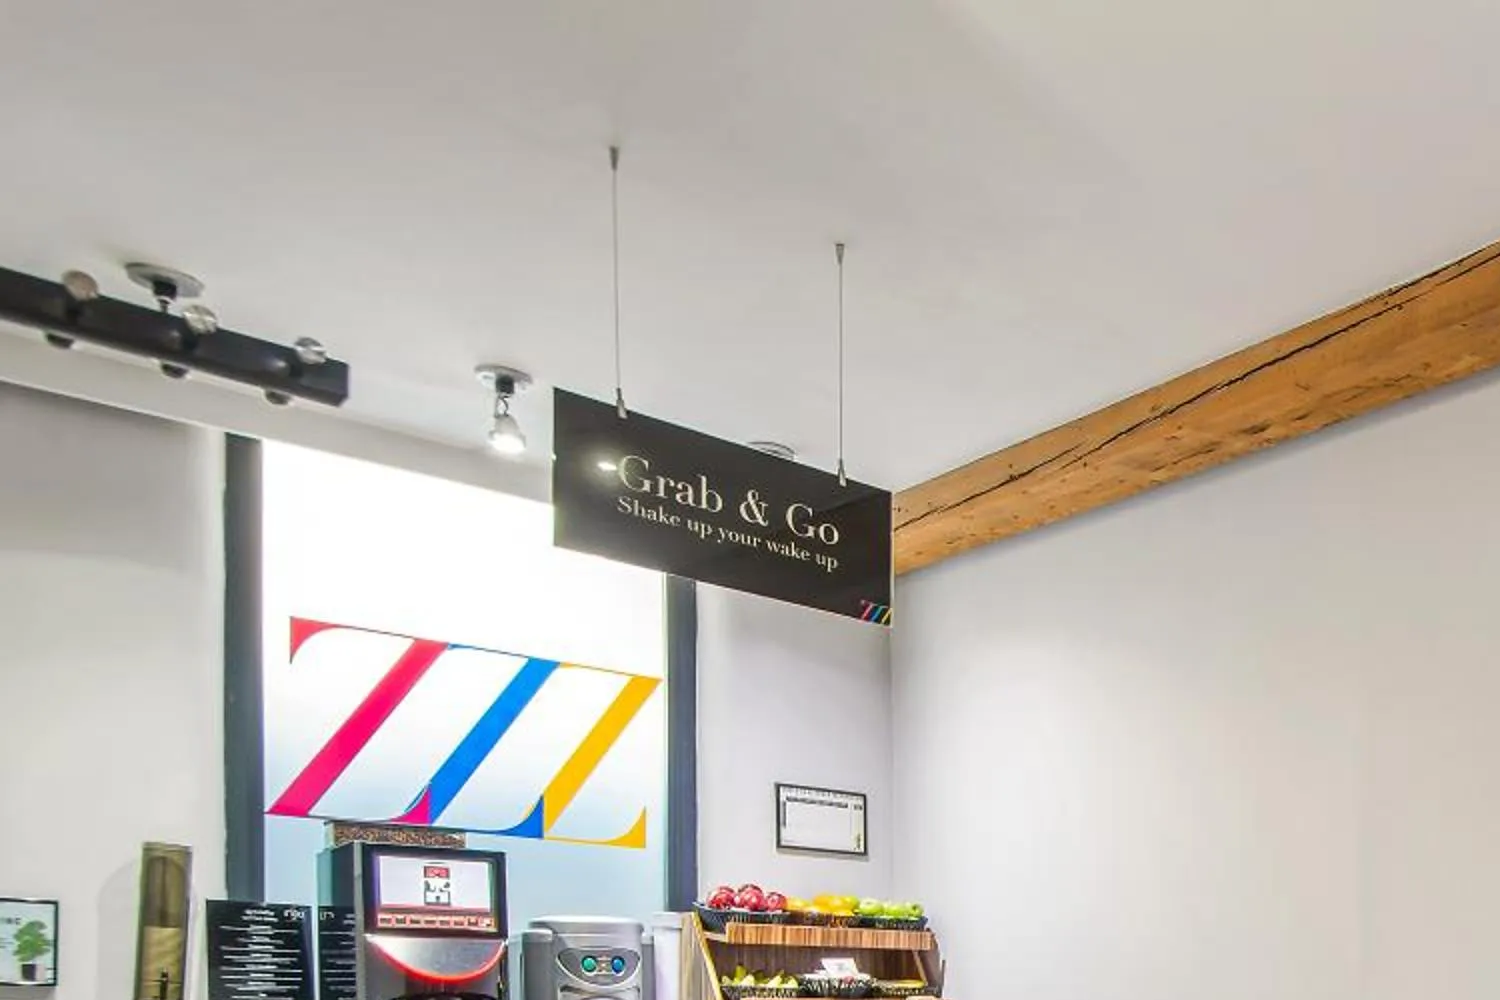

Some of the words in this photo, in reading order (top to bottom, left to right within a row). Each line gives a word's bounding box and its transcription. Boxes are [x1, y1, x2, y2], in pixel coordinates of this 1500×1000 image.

[617, 496, 680, 527] Shake
[687, 520, 713, 538] up
[717, 526, 761, 548] your
[766, 540, 811, 561] wake
[815, 554, 839, 572] up
[619, 455, 723, 512] Grab
[739, 489, 769, 527] &
[785, 503, 839, 545] Go
